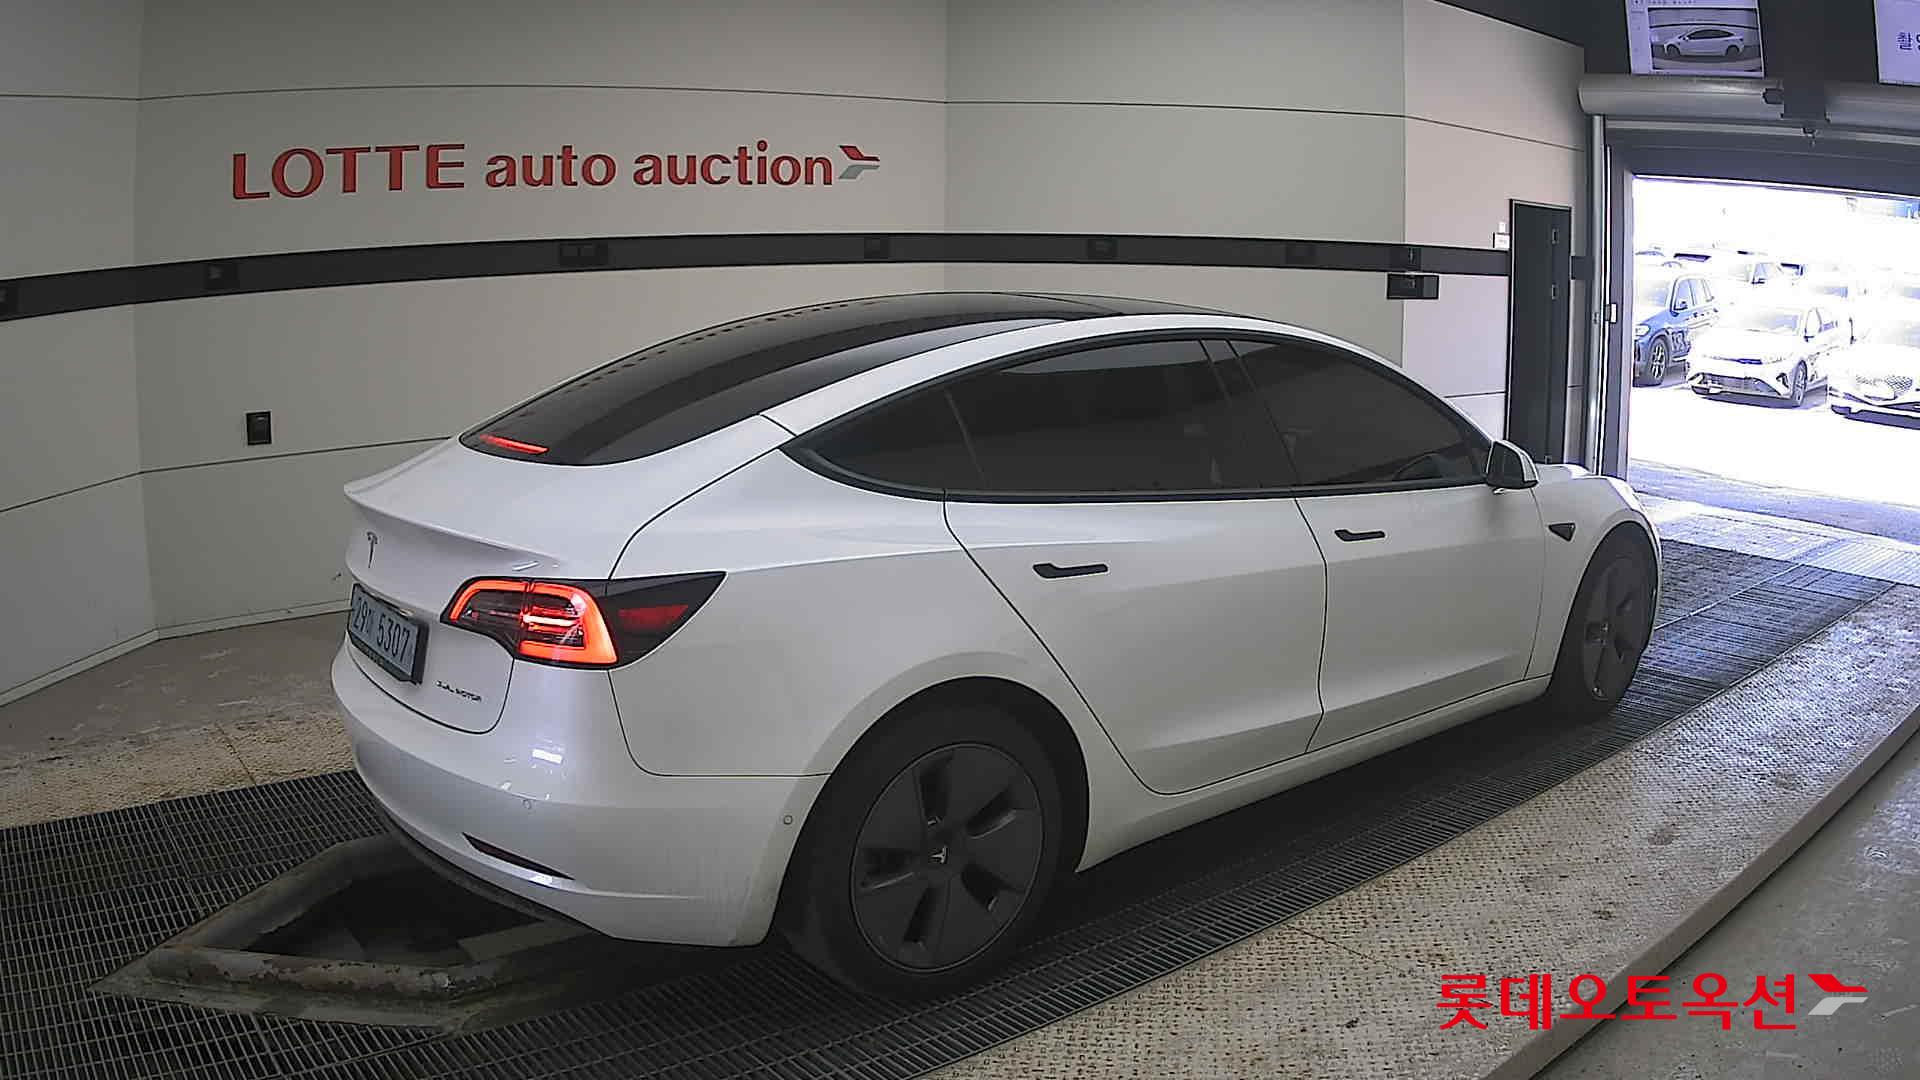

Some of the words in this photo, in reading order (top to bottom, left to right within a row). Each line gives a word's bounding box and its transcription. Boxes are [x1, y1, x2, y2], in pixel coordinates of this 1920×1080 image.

[1896, 31, 1920, 51] 촬
[232, 143, 466, 198] LOTTE
[485, 145, 617, 187] auto
[633, 139, 833, 185] auction
[353, 597, 374, 634] 29
[375, 612, 411, 663] 5307
